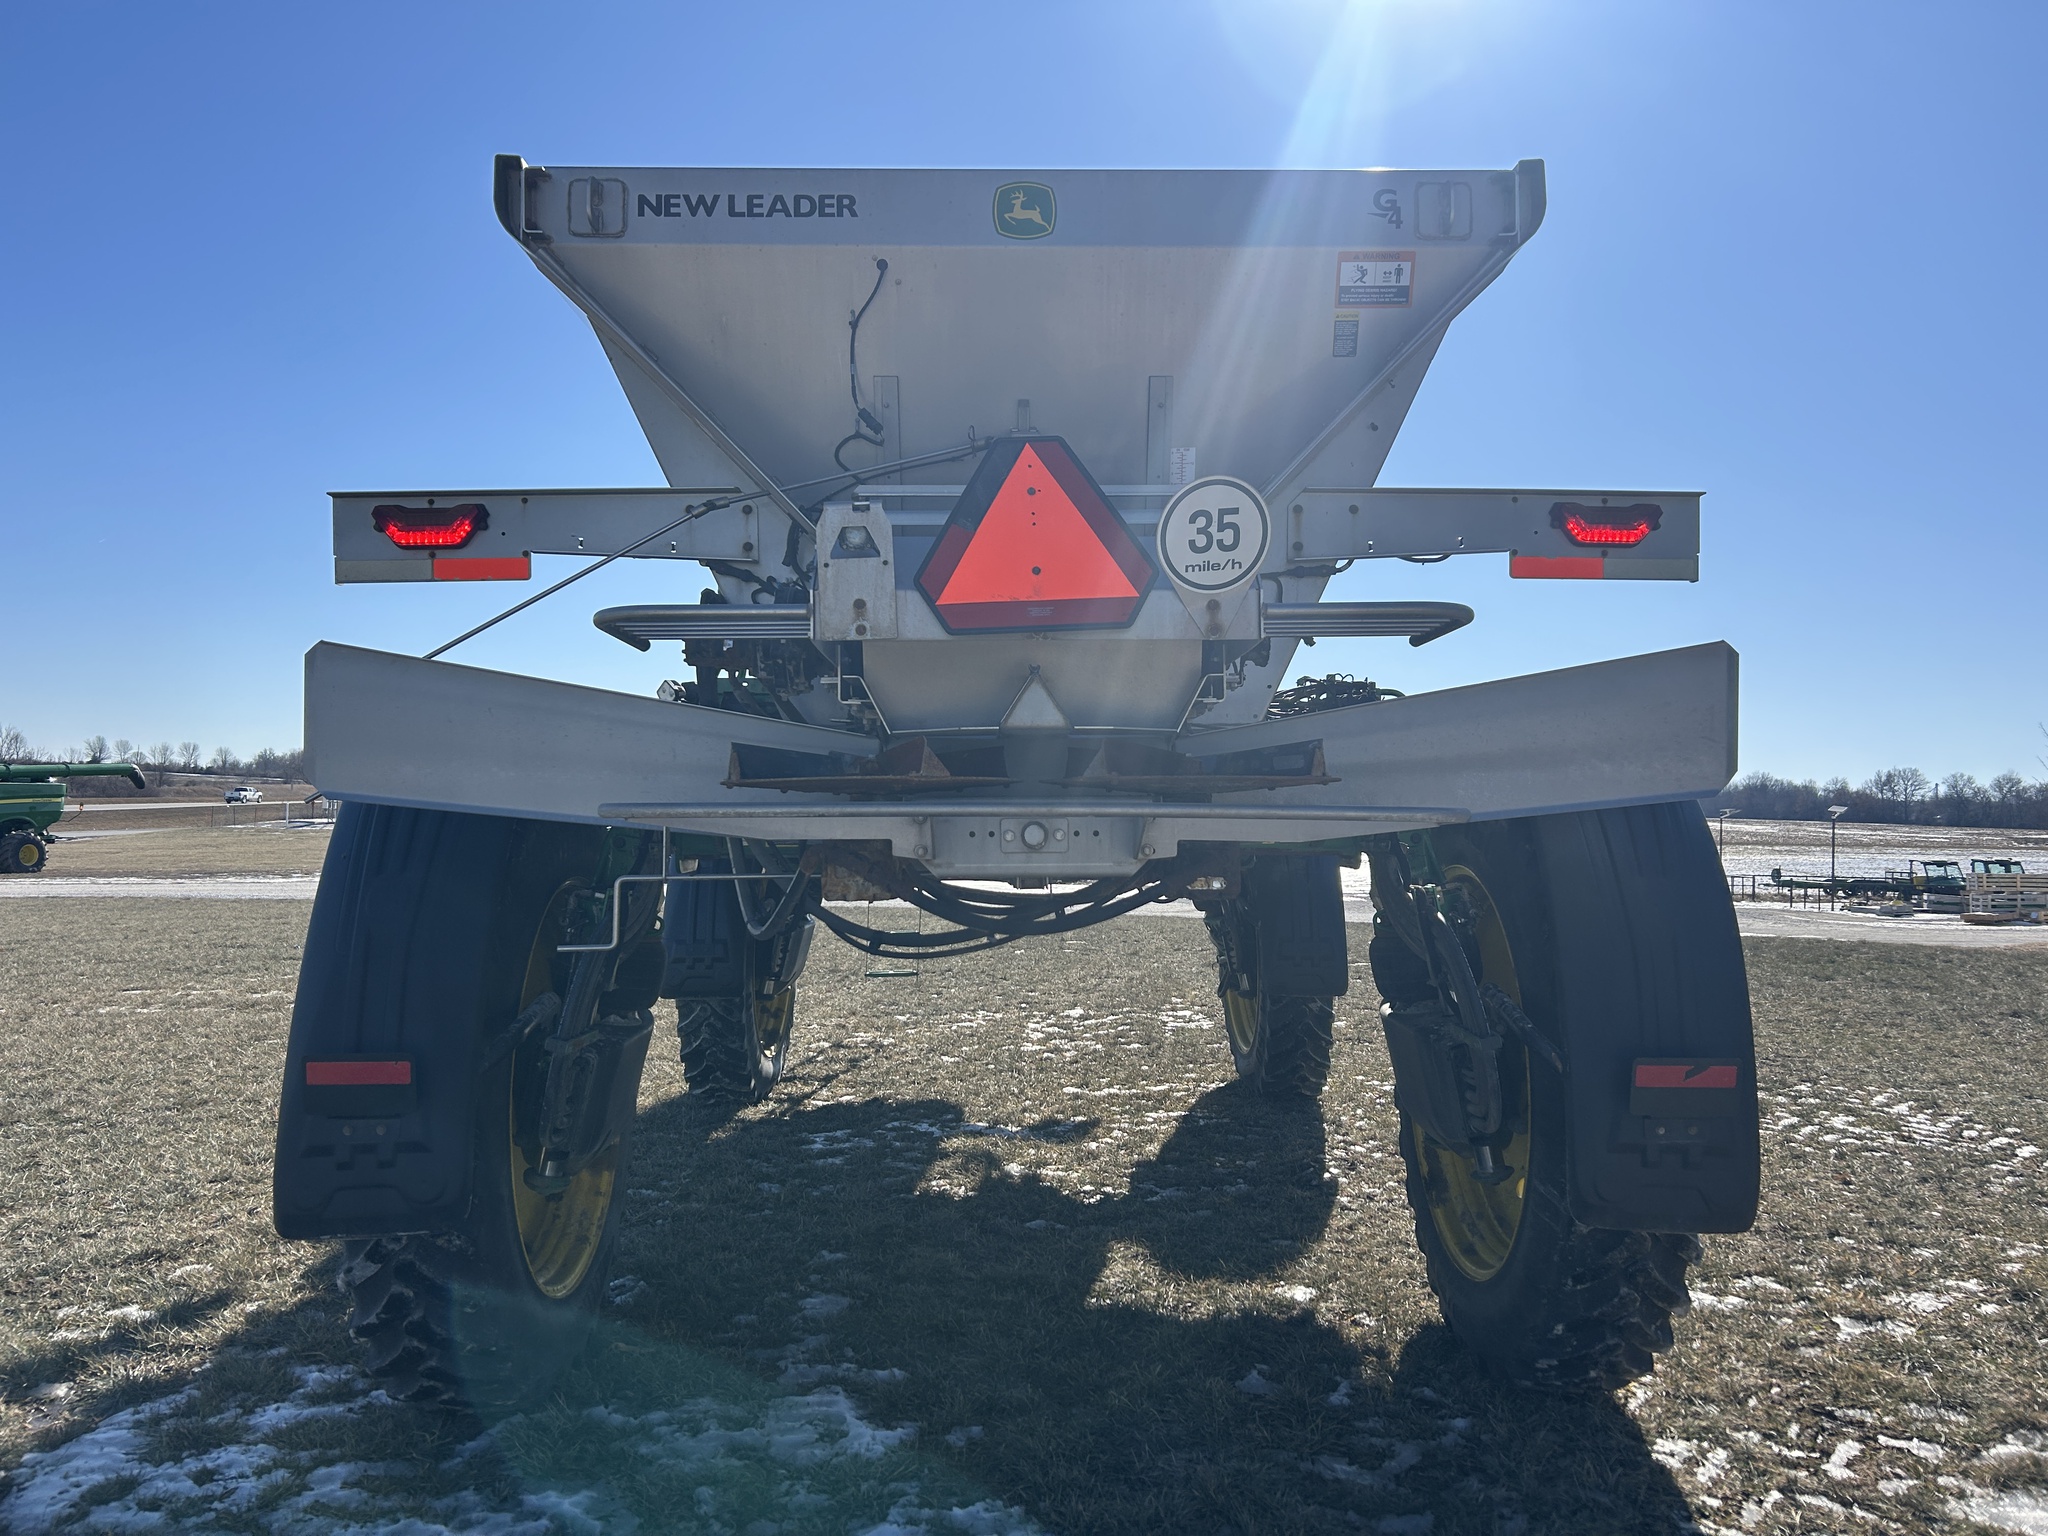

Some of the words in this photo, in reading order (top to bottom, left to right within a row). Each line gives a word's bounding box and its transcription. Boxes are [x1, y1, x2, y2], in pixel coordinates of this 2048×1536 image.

[637, 193, 721, 218] NEW
[727, 193, 859, 218] LEADER
[1362, 252, 1401, 260] WARNING
[1187, 506, 1241, 555] 35
[1184, 558, 1243, 573] mile/h
